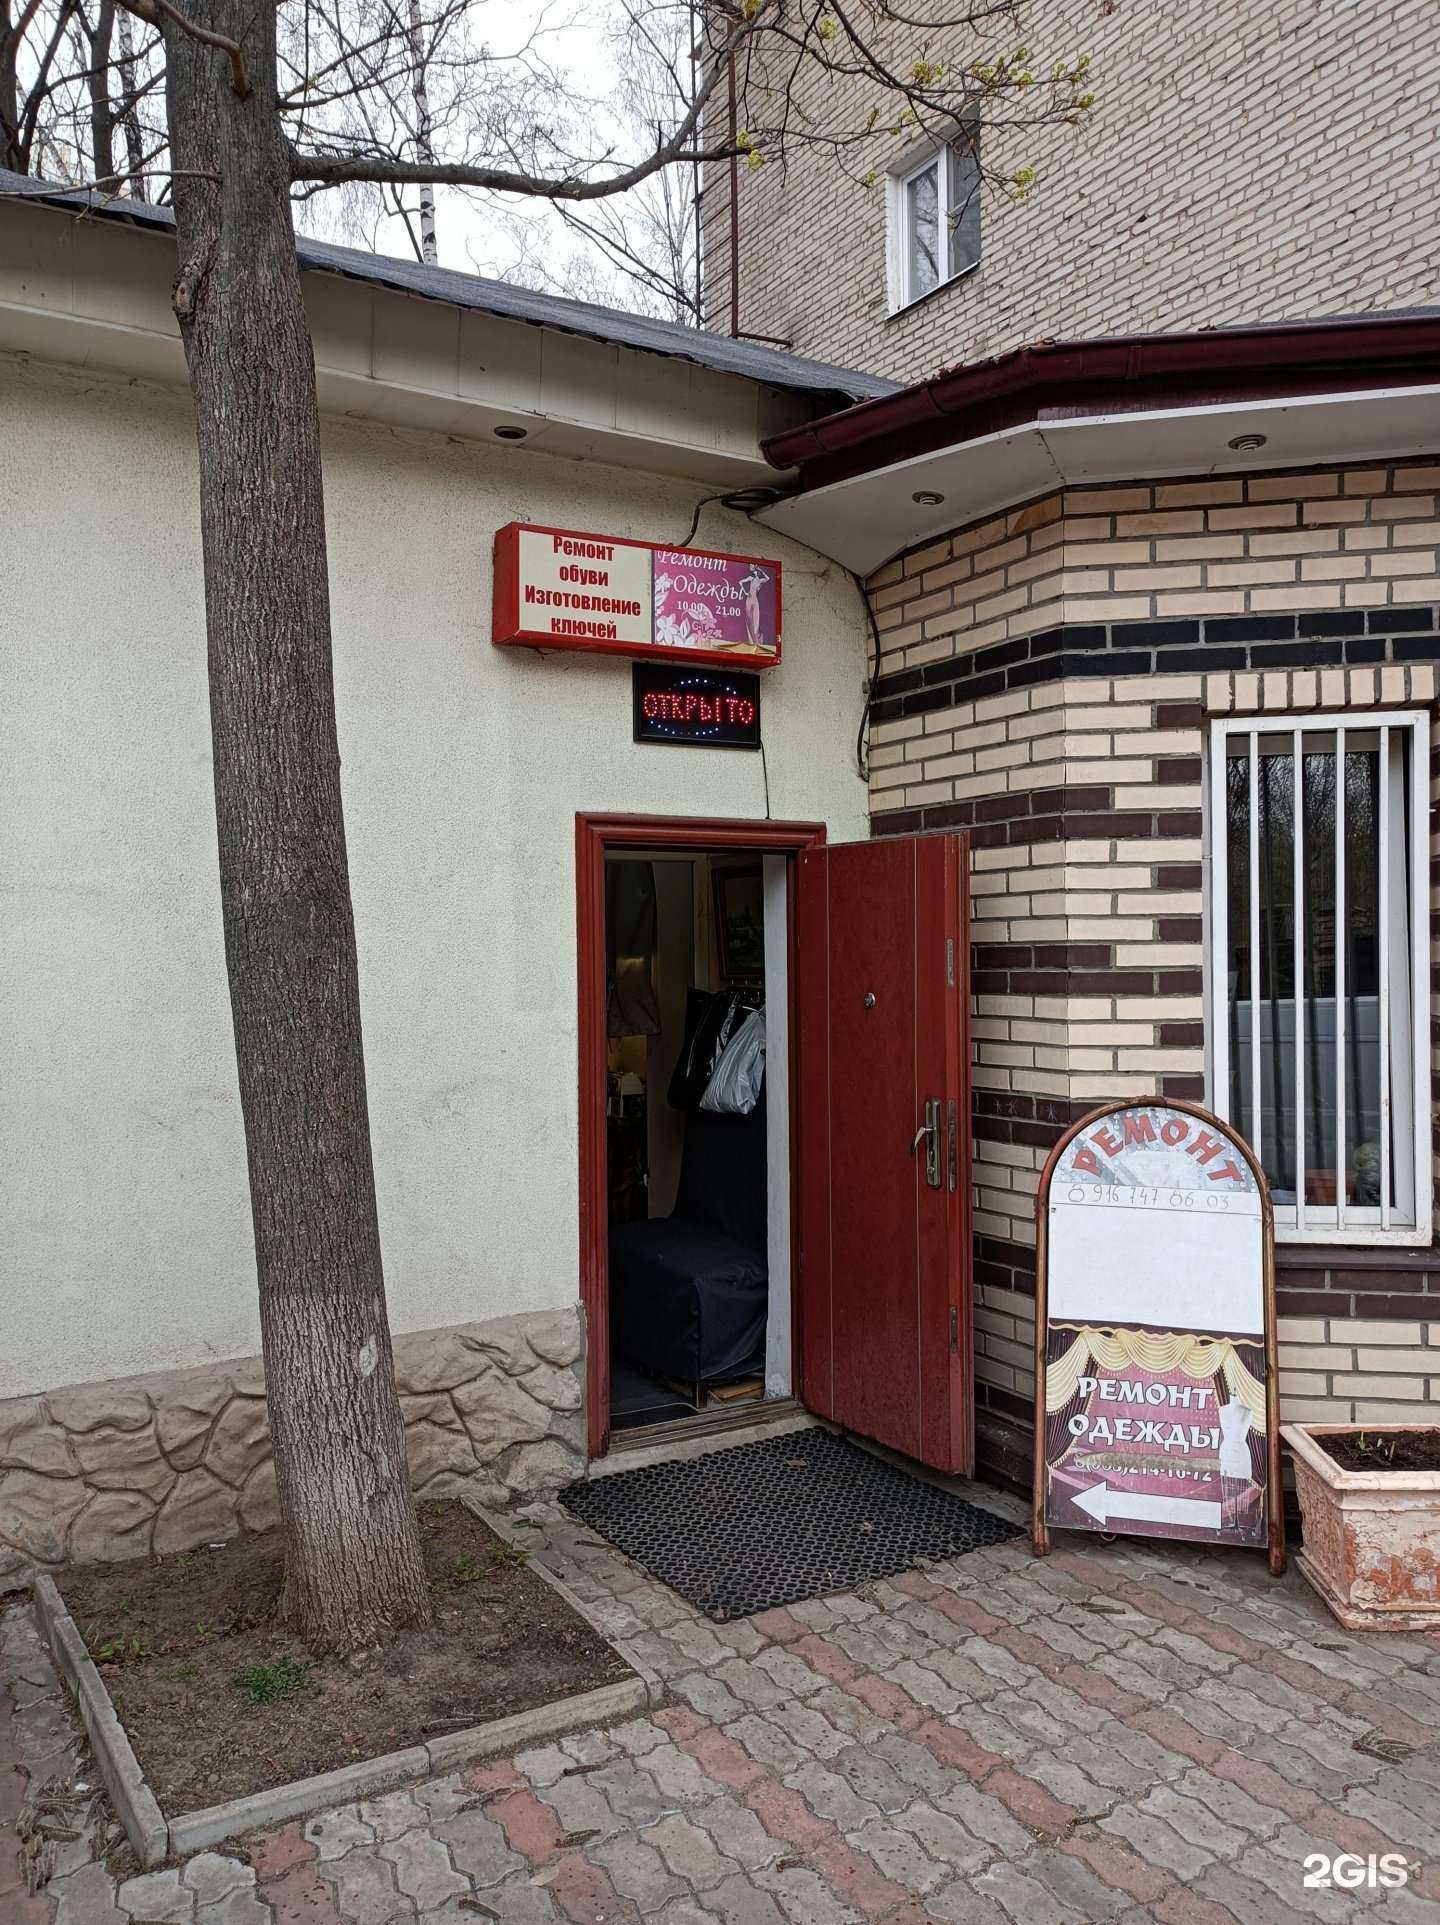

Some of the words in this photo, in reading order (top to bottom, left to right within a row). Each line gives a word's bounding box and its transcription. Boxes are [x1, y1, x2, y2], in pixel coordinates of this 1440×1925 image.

[553, 535, 615, 562] Ремонт
[657, 550, 728, 572] Ремонт
[559, 565, 609, 587] обуви
[673, 573, 744, 602] Одежды
[525, 585, 641, 616] Изготовление
[715, 605, 741, 617] 21.00
[551, 618, 617, 639] ключей
[643, 693, 753, 725] ОТКРЫТО
[1071, 1114, 1243, 1183] РЕМОНТ
[1076, 1375, 1214, 1410] РЕМОНТ
[1067, 1413, 1222, 1454] ОДЕЖДЫ
